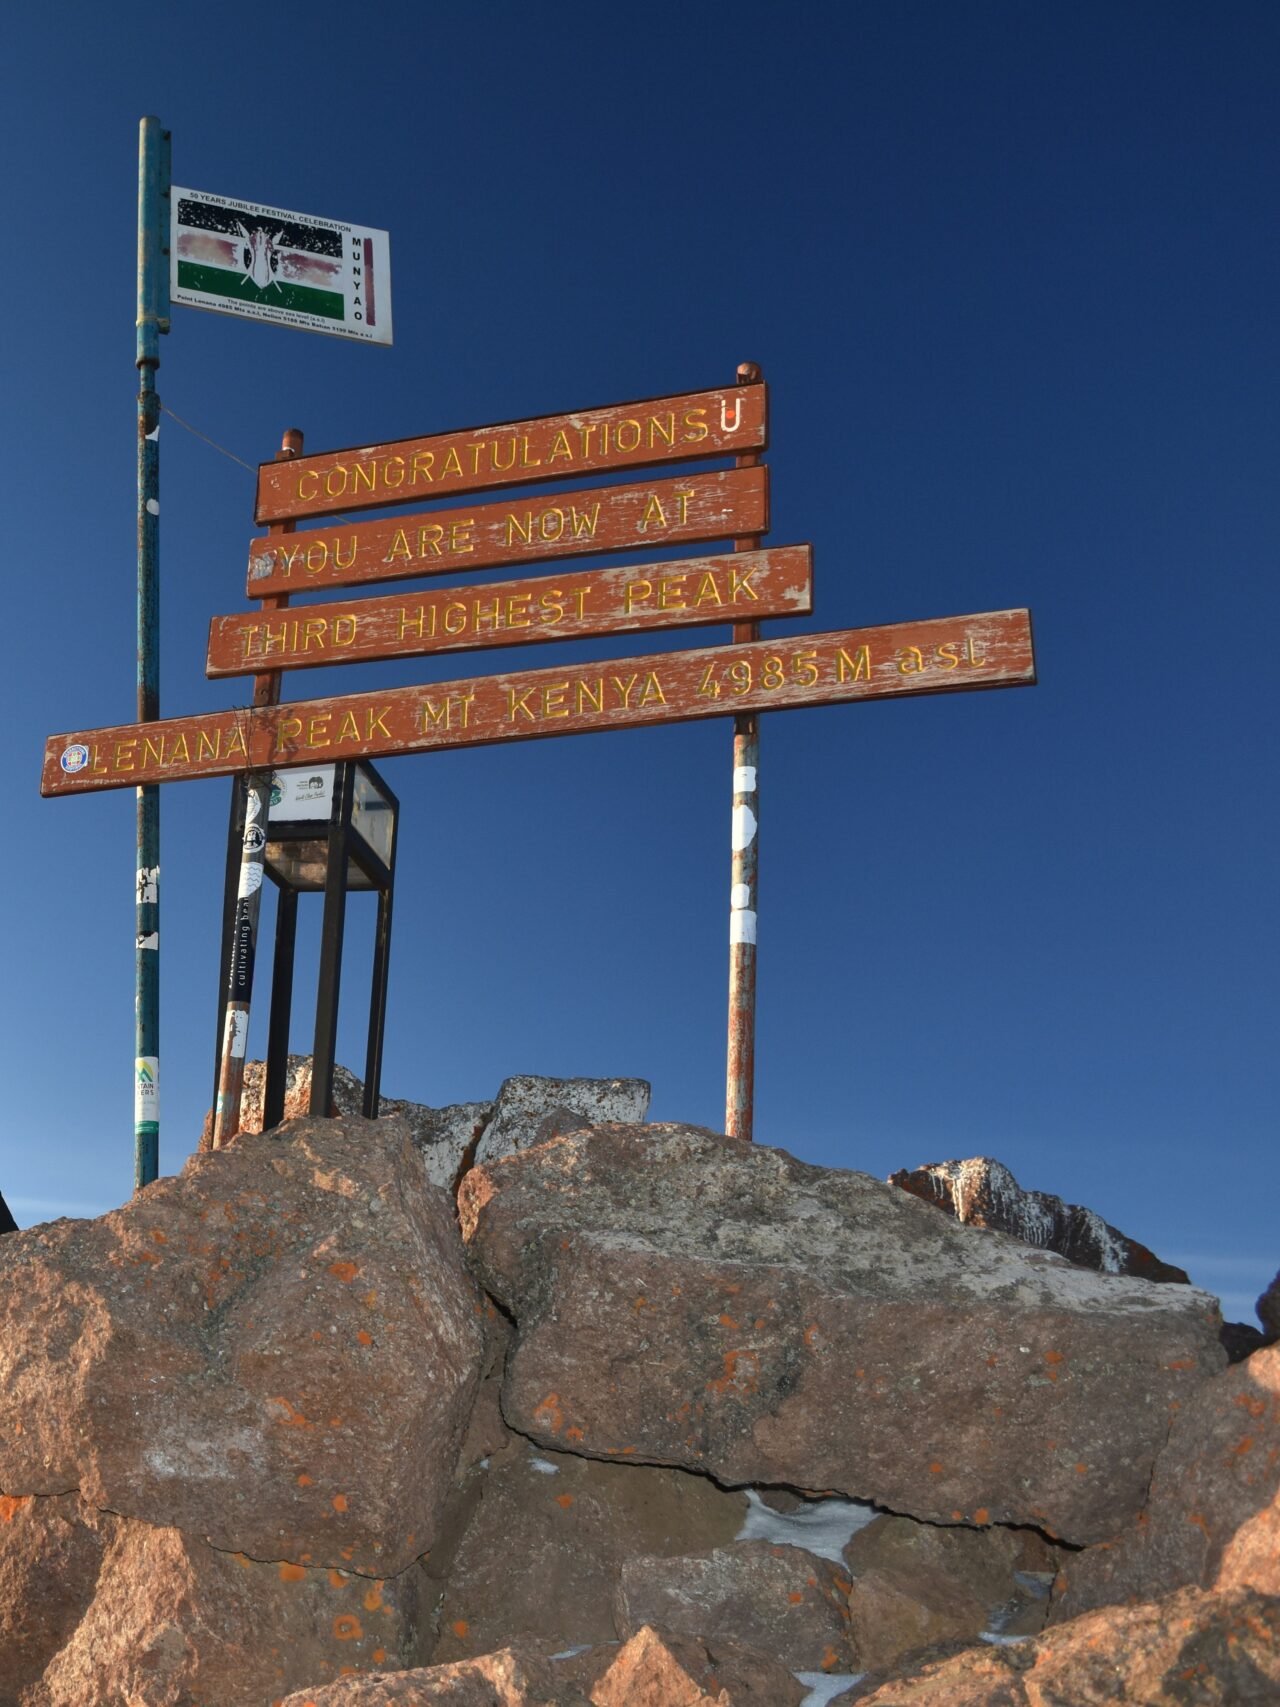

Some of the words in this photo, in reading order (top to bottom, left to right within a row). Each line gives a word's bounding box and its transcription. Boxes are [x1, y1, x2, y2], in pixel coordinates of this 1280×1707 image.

[201, 194, 226, 205] YEARS
[228, 201, 260, 212] JUBILEE
[261, 208, 297, 220] FESTIVAL
[299, 216, 352, 232] CELEBRATION
[296, 408, 709, 501] CONGRATULATIONS
[277, 535, 358, 577] YOU
[382, 518, 475, 562] ARE
[504, 502, 600, 547] NOW
[637, 489, 695, 533] AT
[240, 614, 357, 657] THIRD
[396, 586, 591, 640] HIGHEST
[623, 567, 759, 615] PEAK
[87, 727, 248, 774] LENANA
[276, 706, 392, 753] PEAK
[419, 694, 475, 733] MT
[507, 671, 667, 722] KENYA
[697, 650, 819, 699] 4985
[835, 645, 871, 683] M
[237, 925, 251, 986] cultivating
